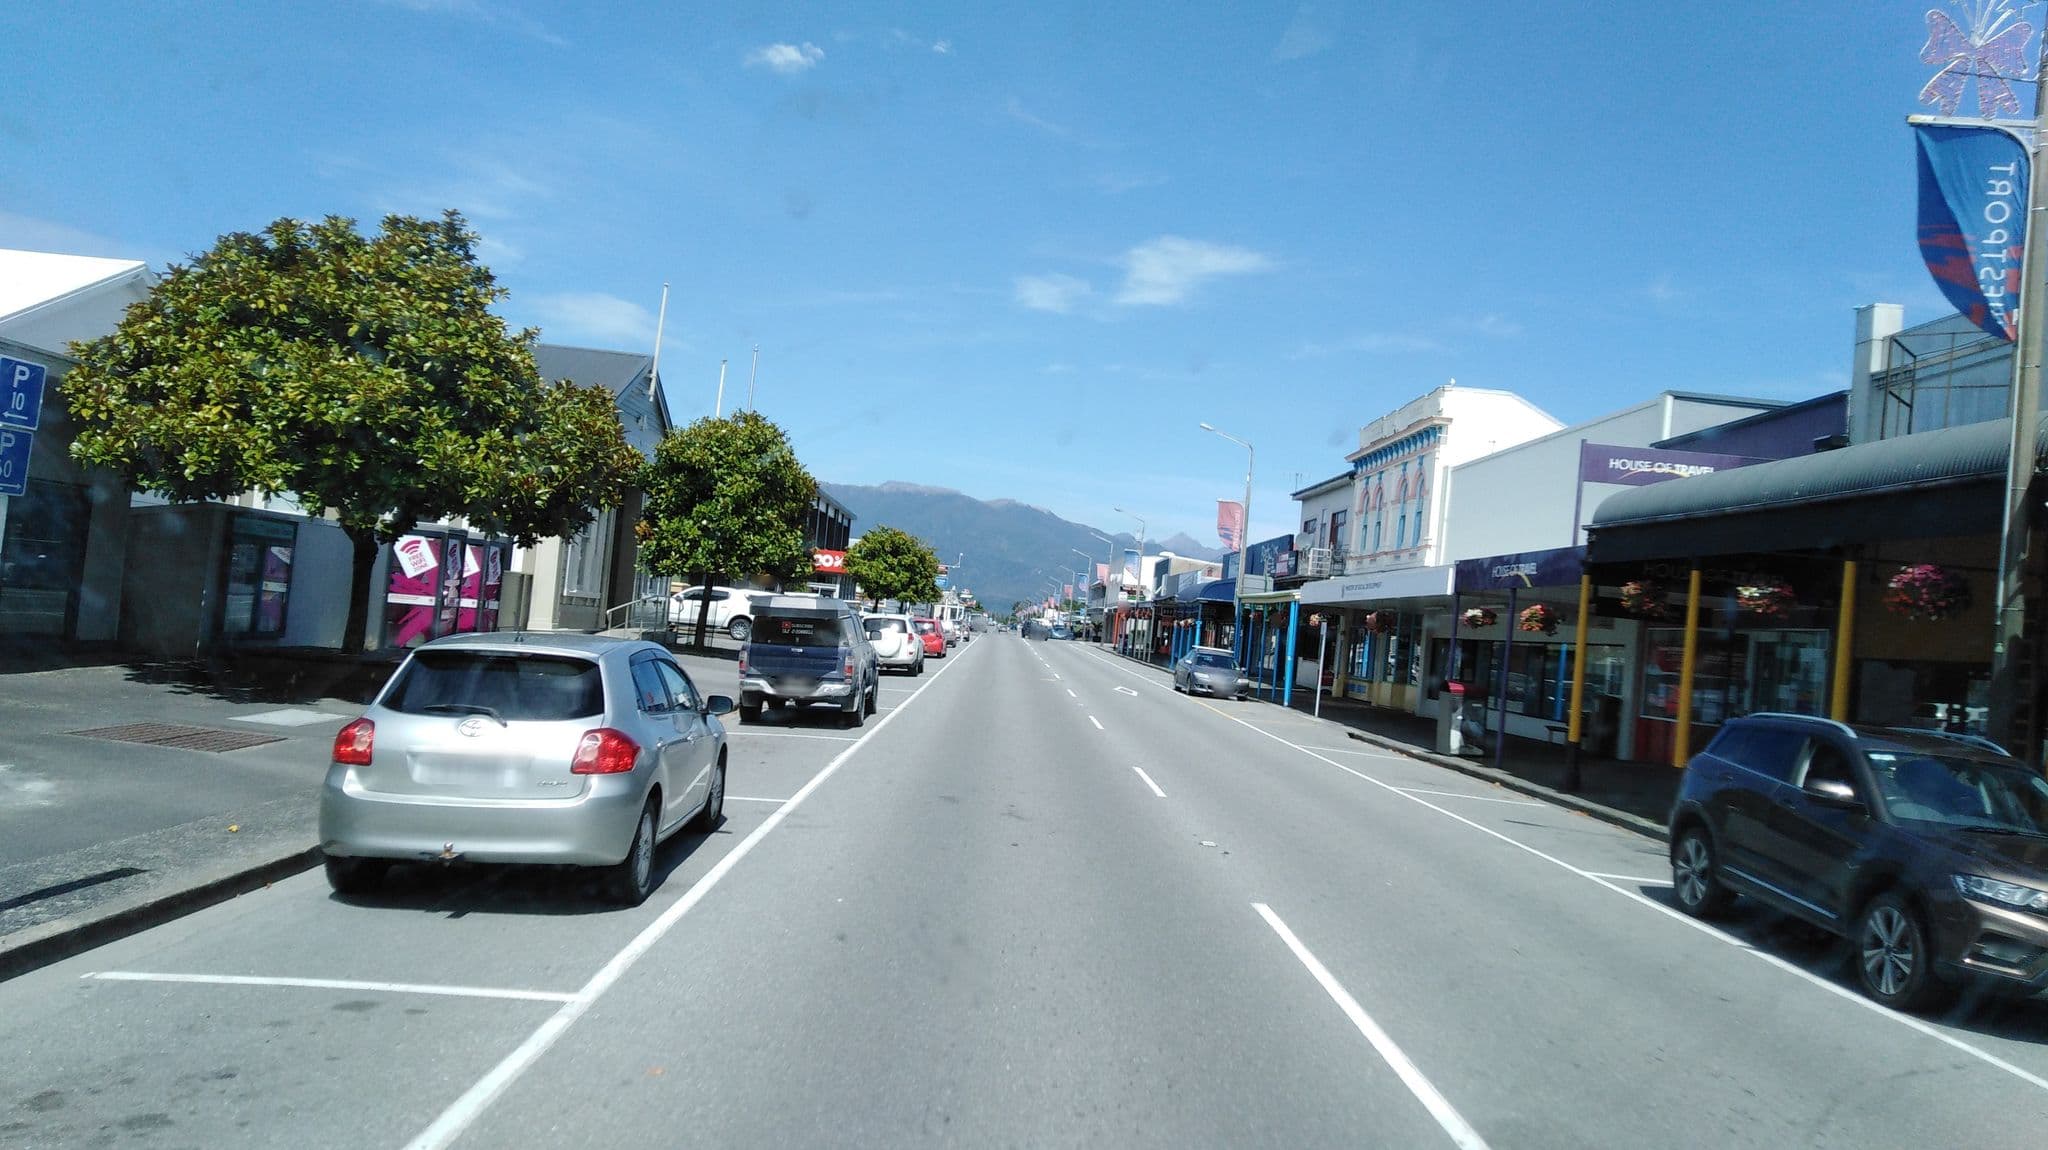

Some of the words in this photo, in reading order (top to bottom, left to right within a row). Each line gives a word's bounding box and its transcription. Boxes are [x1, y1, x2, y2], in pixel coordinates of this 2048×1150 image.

[13, 365, 30, 388] P
[11, 391, 25, 411] 10
[0, 432, 16, 455] P
[1609, 458, 1653, 472] HOUSE
[1653, 462, 1673, 473] OF
